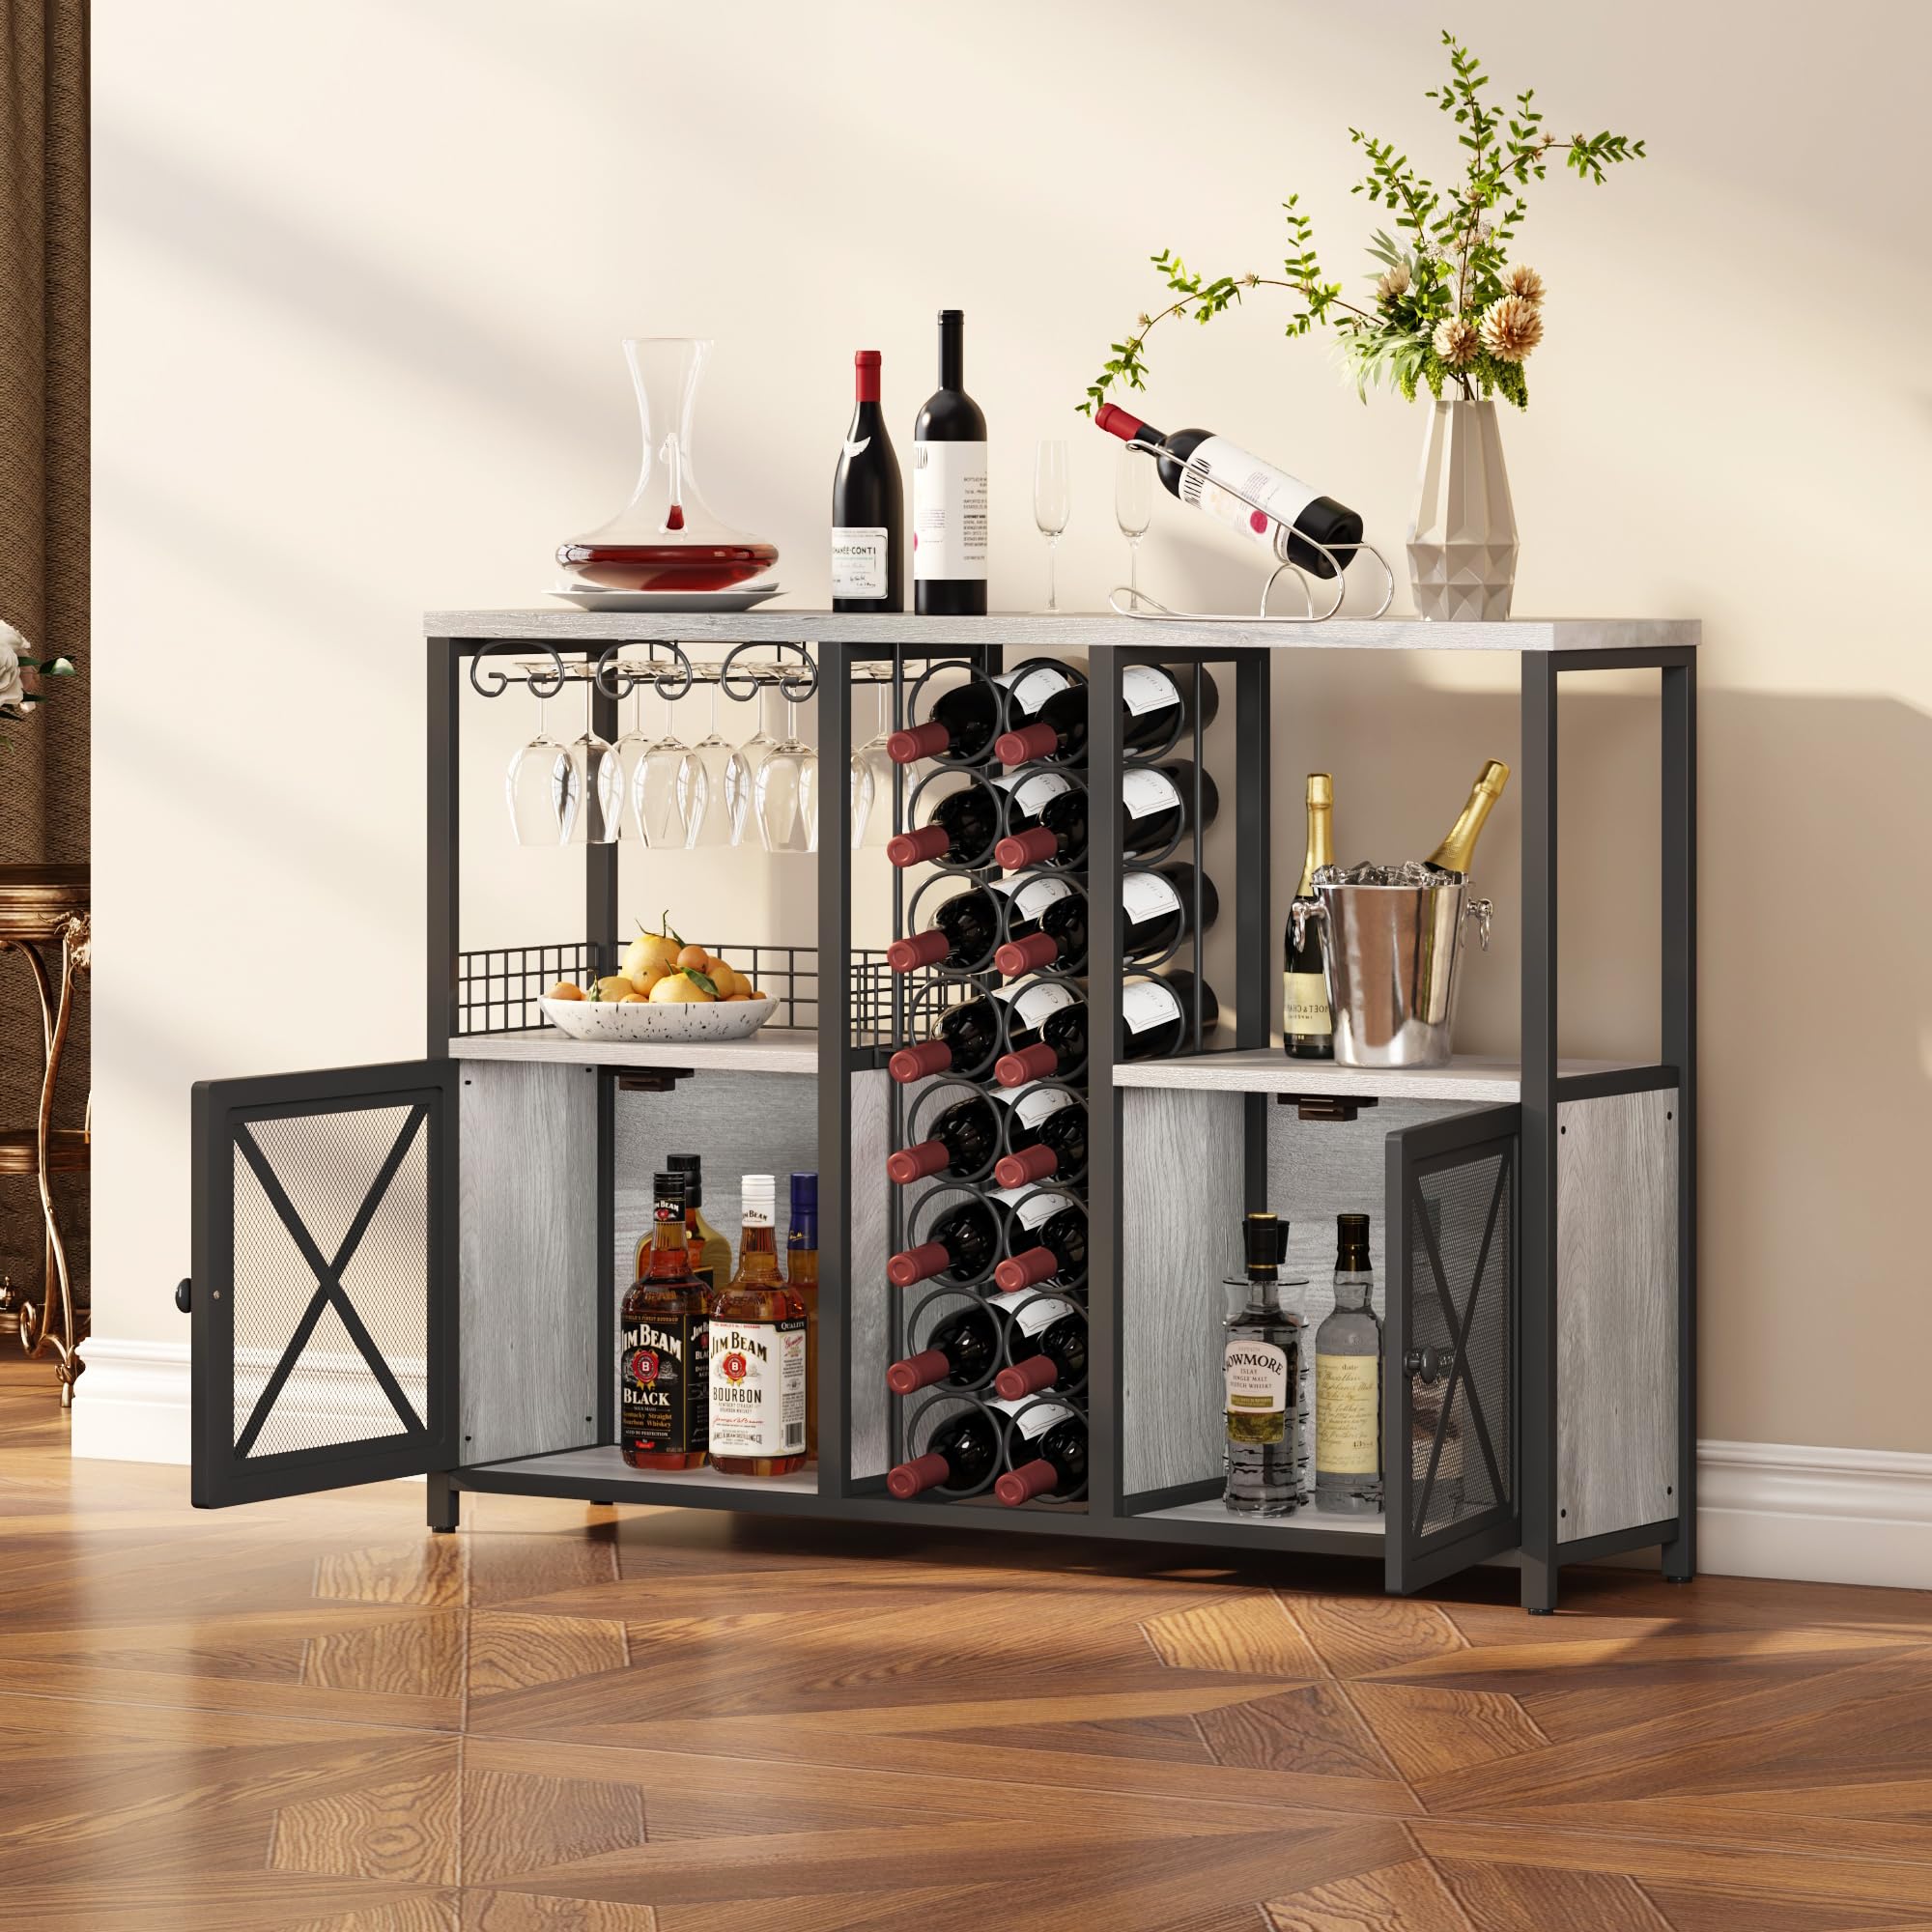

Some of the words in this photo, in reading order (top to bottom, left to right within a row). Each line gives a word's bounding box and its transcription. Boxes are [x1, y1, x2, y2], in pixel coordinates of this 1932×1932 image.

[639, 1323, 683, 1362] BEAM
[710, 1336, 729, 1359] JIM
[731, 1331, 767, 1363] BEAM
[623, 1387, 670, 1406] BLACK
[713, 1387, 762, 1404] BOURBON
